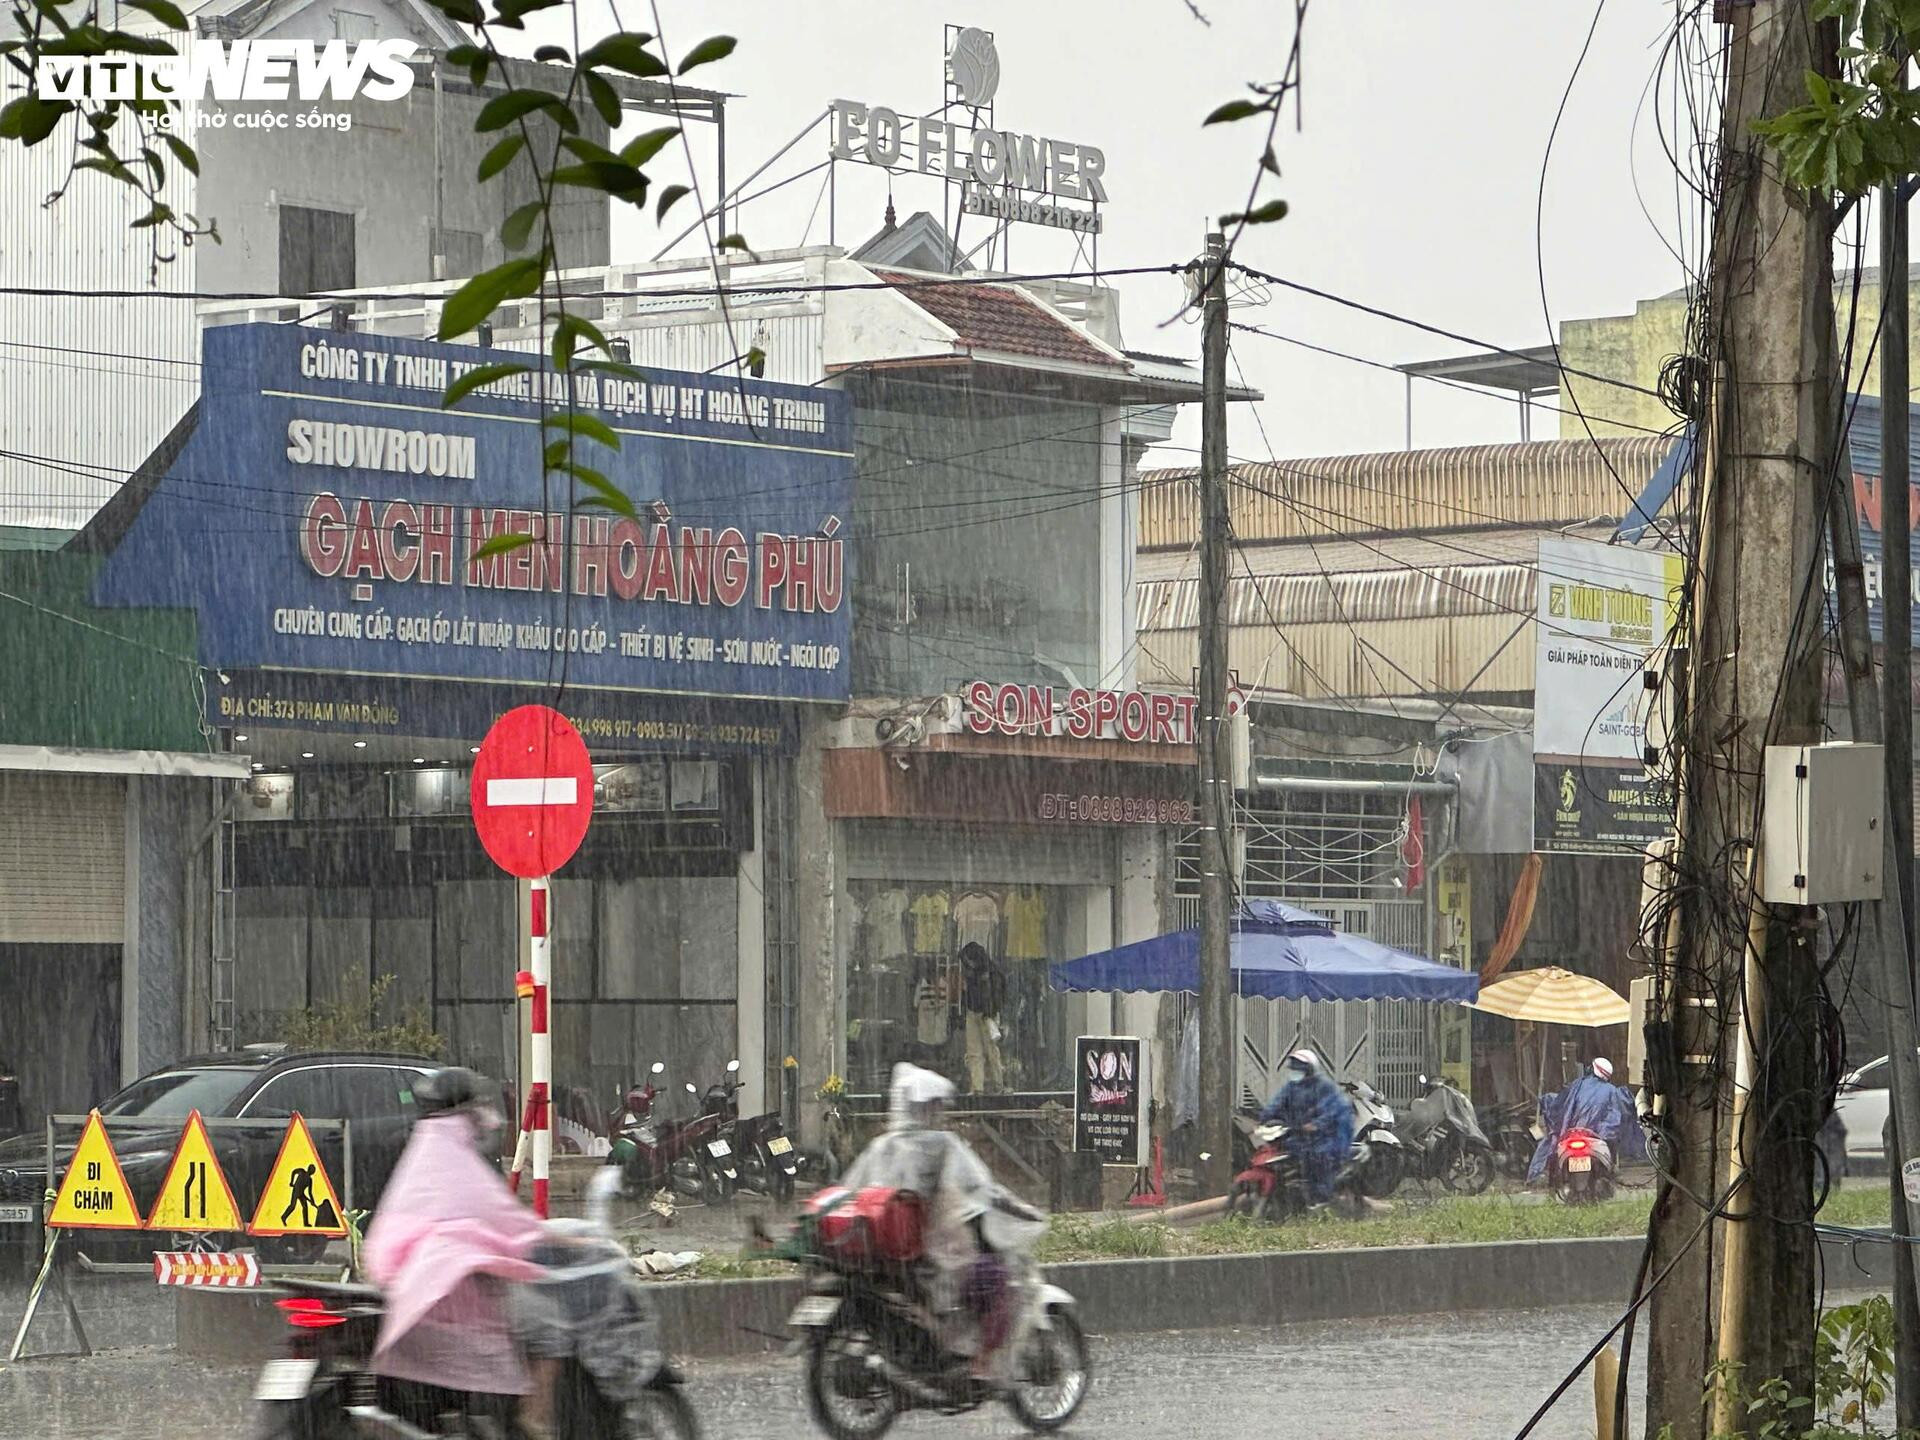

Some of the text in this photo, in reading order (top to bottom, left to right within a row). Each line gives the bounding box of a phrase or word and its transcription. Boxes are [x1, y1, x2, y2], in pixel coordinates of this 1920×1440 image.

[829, 98, 1108, 203] FO FLOWER
[301, 339, 359, 381] CÔNG
[362, 351, 389, 384] TY
[393, 354, 447, 392] TNHH
[575, 370, 600, 410] VÀ
[603, 378, 647, 418] DỊCH
[651, 385, 676, 424] VỤ
[679, 387, 704, 421] HT
[707, 387, 769, 428] HOÀNG
[286, 418, 476, 480] SHOWROOM
[299, 491, 843, 614] GẠCH MEN HOÀNG PHÚ
[274, 604, 325, 636] CHUYÊN
[328, 611, 362, 640] CUNG
[364, 606, 394, 641] CẤP:
[396, 617, 430, 646] GẠCH
[432, 610, 450, 644] ỐP
[452, 615, 476, 646] LÁT
[478, 618, 513, 652] NHẬP
[515, 616, 550, 651] KHẨU
[581, 621, 607, 655] CẤP
[619, 624, 651, 657] THIẾT
[653, 634, 666, 662] BỊ
[668, 631, 684, 664] VỆ
[685, 637, 714, 662] SINH
[790, 640, 817, 669] NGÓI
[1548, 647, 1566, 664] GIẢI
[1567, 649, 1588, 666] PHÁP
[1590, 652, 1612, 668] TOÀN
[1614, 654, 1632, 673] DIỆN
[221, 697, 245, 721] ĐỊA
[296, 701, 334, 726] PHẠM
[968, 680, 1053, 737] SON
[1608, 788, 1641, 808] NHỰA
[1086, 1049, 1133, 1081] SON
[87, 1162, 101, 1181] ĐI
[74, 1188, 113, 1214] CHẬM
